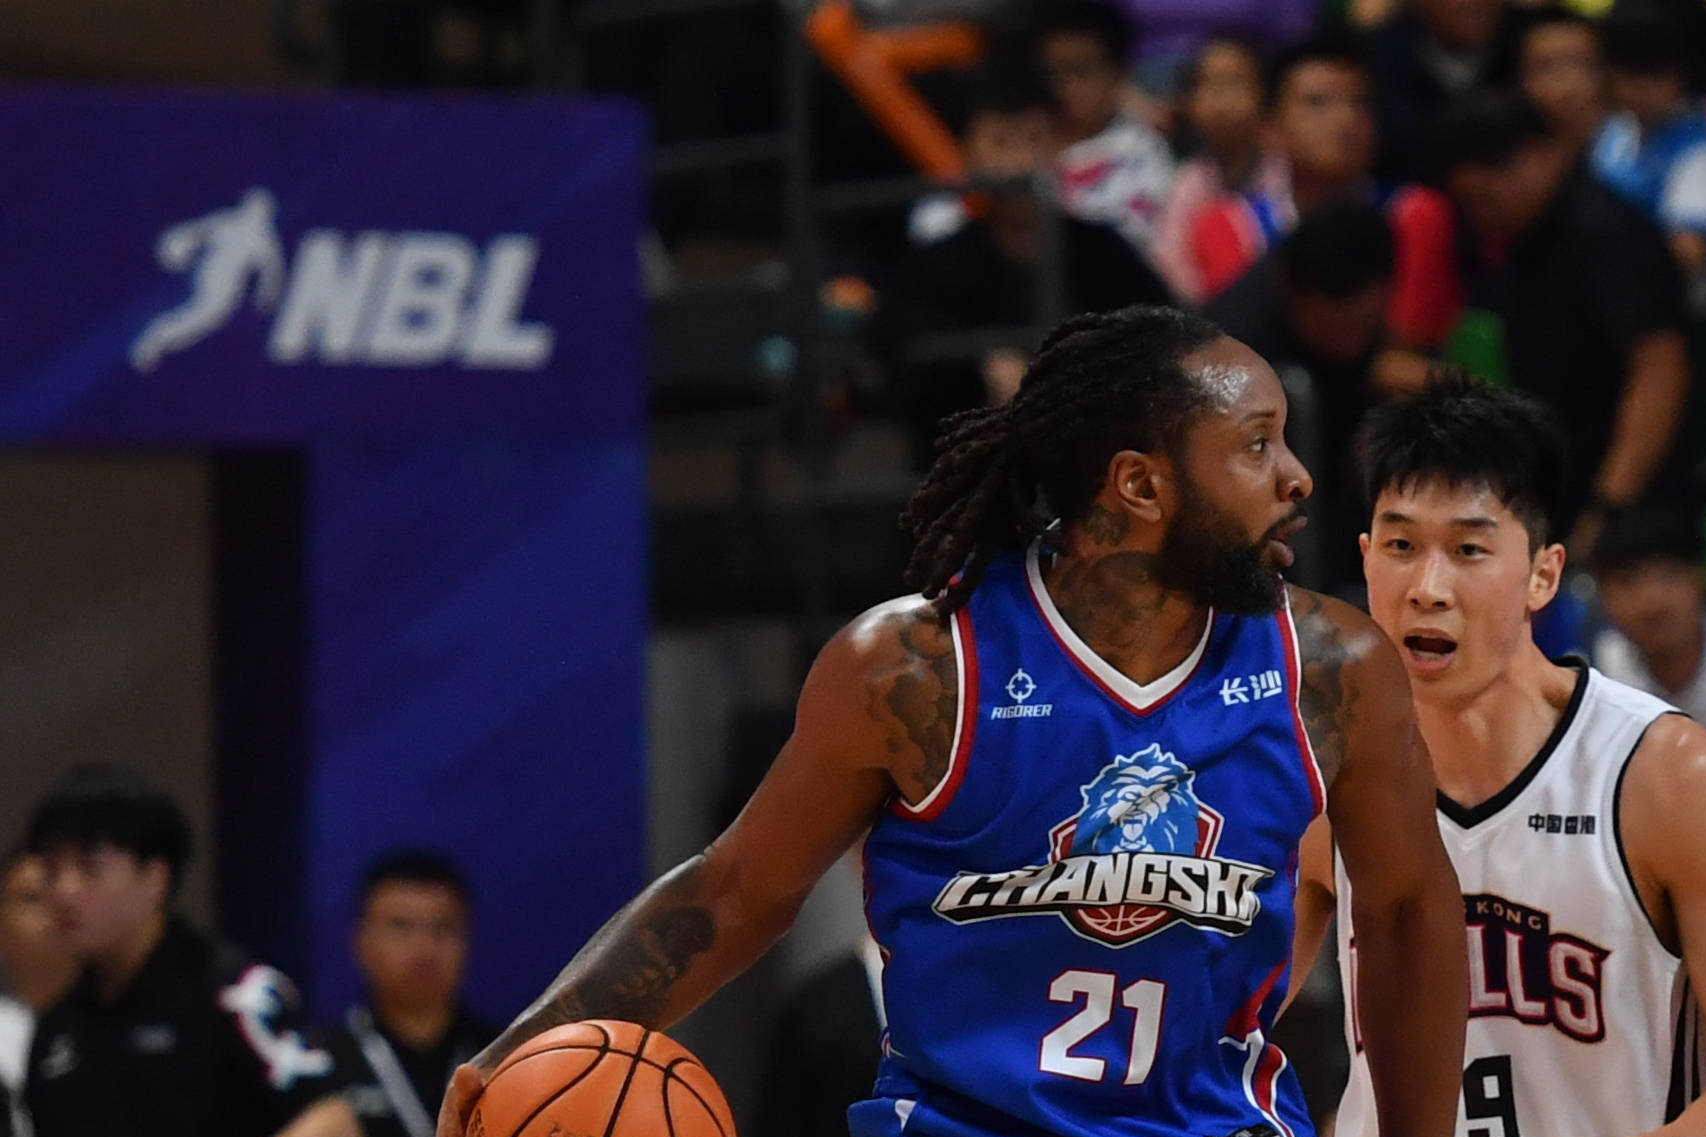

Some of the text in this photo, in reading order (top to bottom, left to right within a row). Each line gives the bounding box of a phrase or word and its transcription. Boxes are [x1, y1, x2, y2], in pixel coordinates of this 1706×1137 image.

[268, 230, 555, 369] NBL
[1219, 669, 1282, 706] 长沙
[991, 703, 1053, 721] RIGORER
[1476, 901, 1543, 931] KONG
[1039, 968, 1167, 1086] 21
